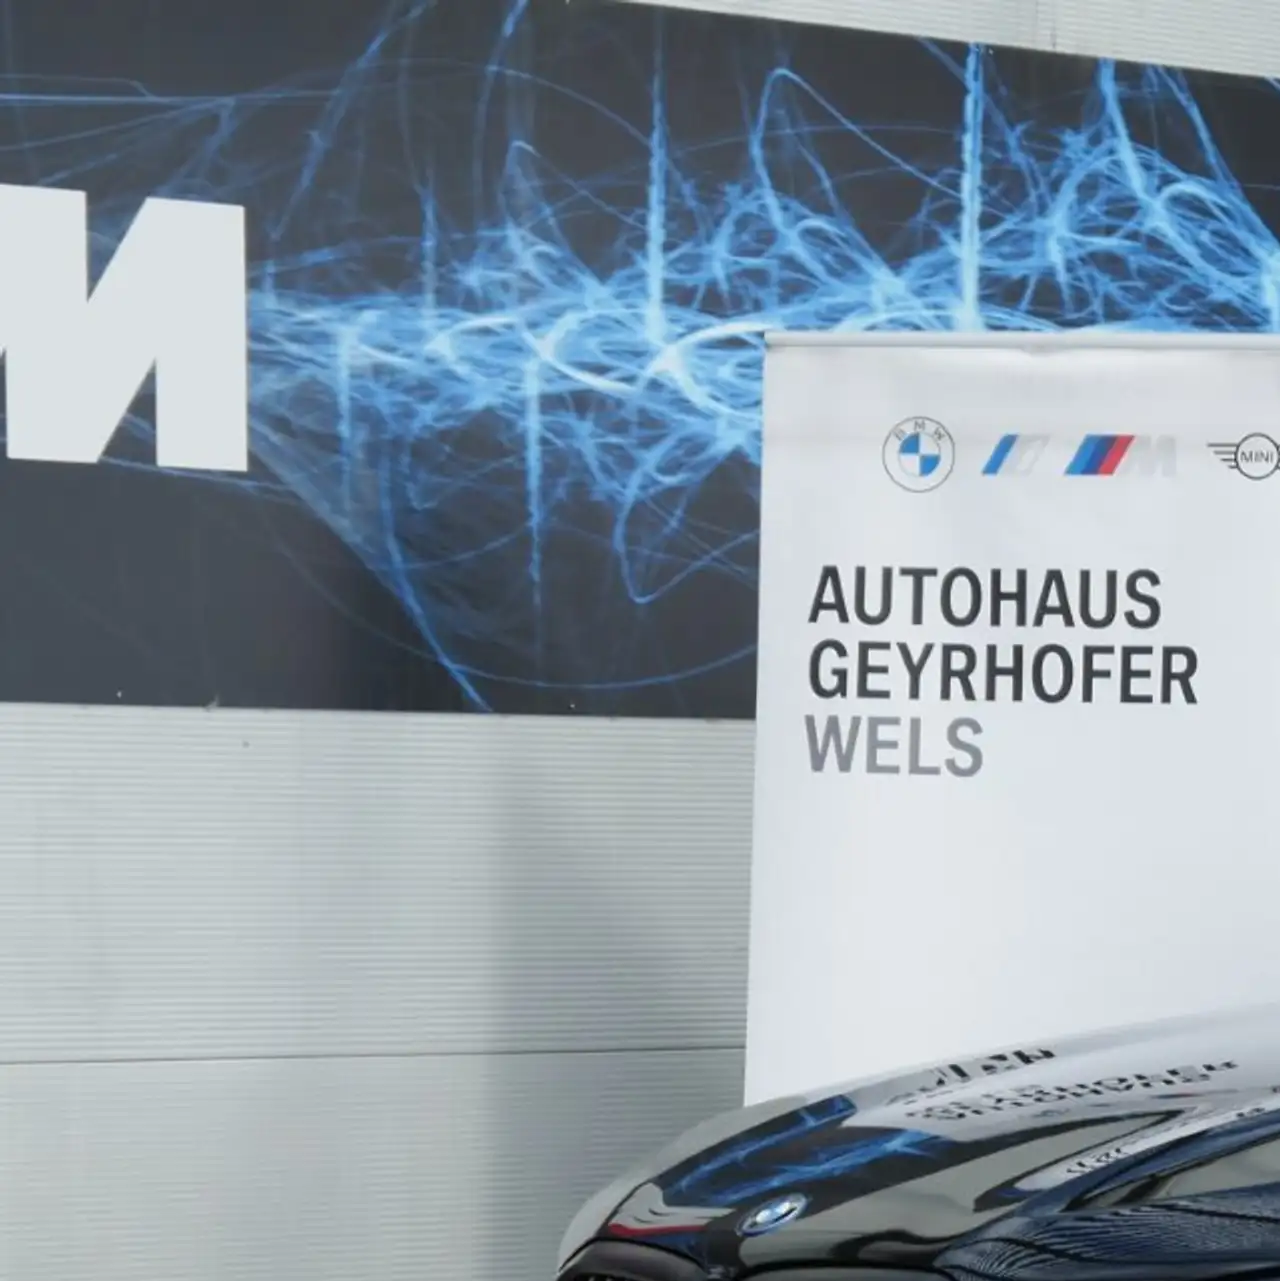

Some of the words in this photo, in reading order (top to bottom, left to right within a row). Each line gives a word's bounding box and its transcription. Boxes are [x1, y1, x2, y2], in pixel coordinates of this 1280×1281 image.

[893, 419, 946, 442] BMW
[1239, 449, 1274, 464] MINI
[808, 565, 1162, 630] AUTOHAUS
[807, 639, 1199, 705] GEYRHOFER
[803, 714, 984, 778] WELS
